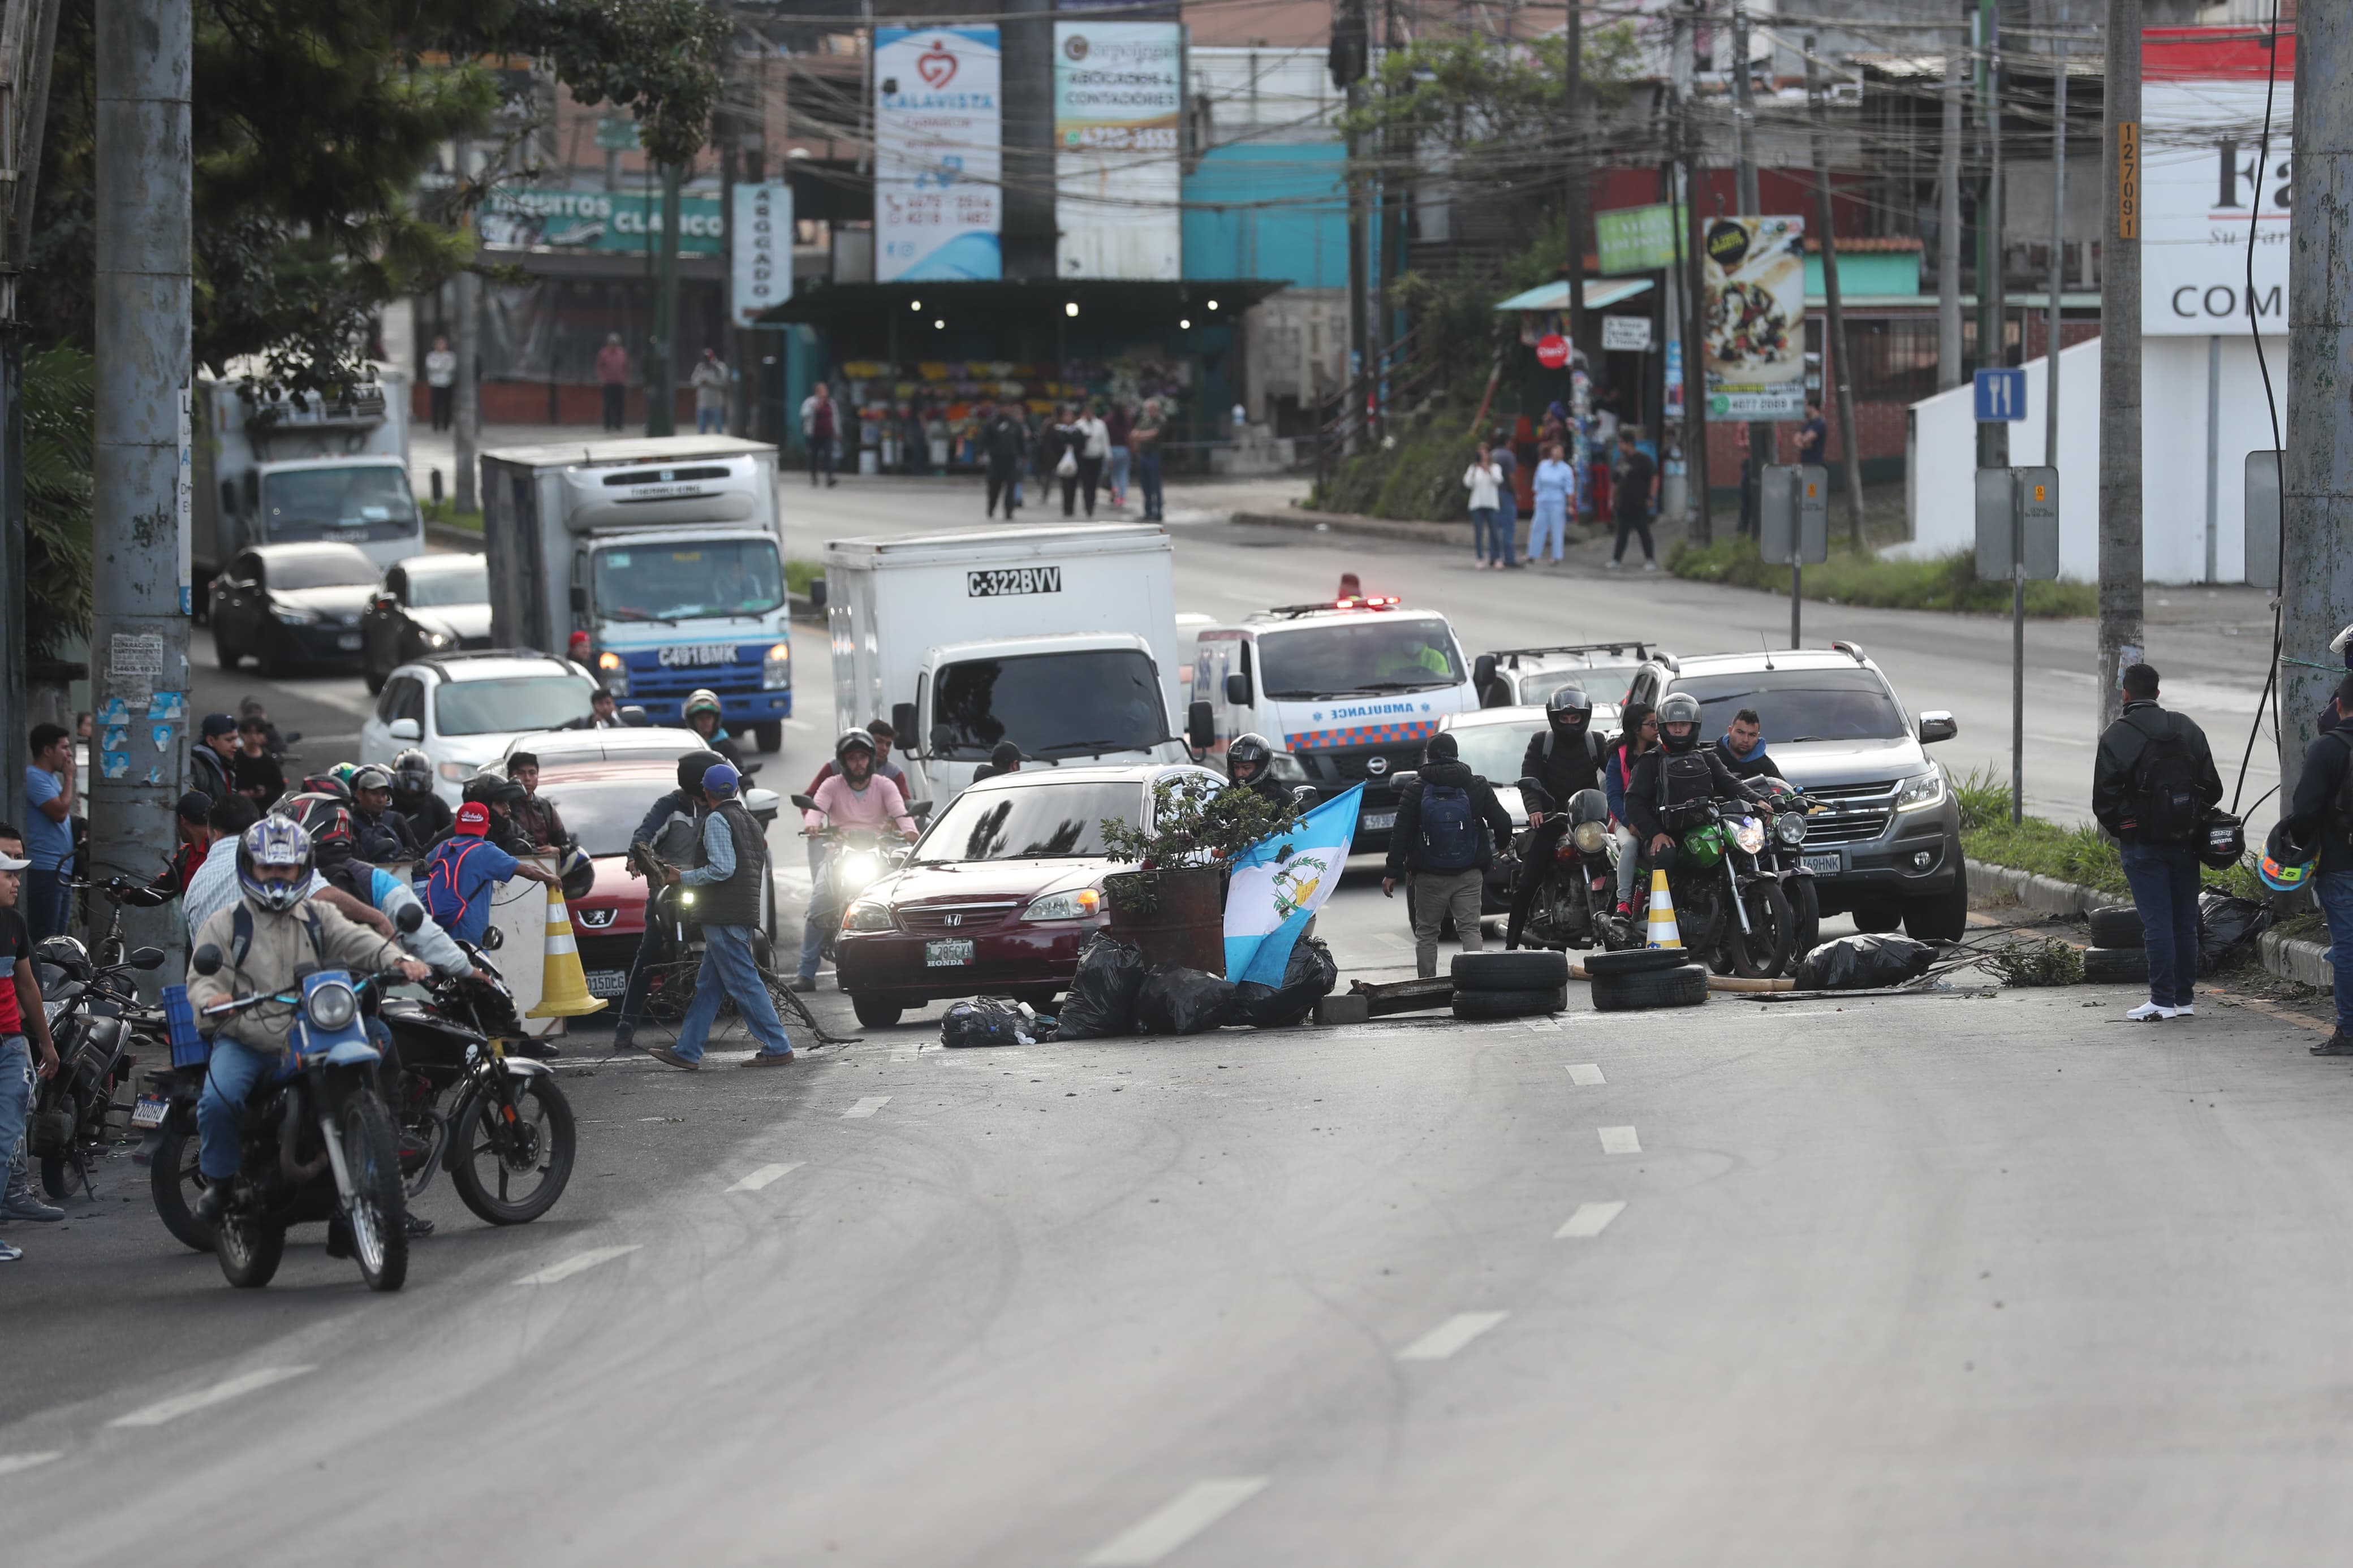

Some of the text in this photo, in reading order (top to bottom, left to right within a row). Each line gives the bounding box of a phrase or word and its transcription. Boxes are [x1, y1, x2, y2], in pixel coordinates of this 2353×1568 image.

[2123, 124, 2134, 236] 127091
[614, 210, 723, 237] CLAICO
[753, 189, 771, 297] ABOGADO
[969, 567, 1059, 596] C-322BVV
